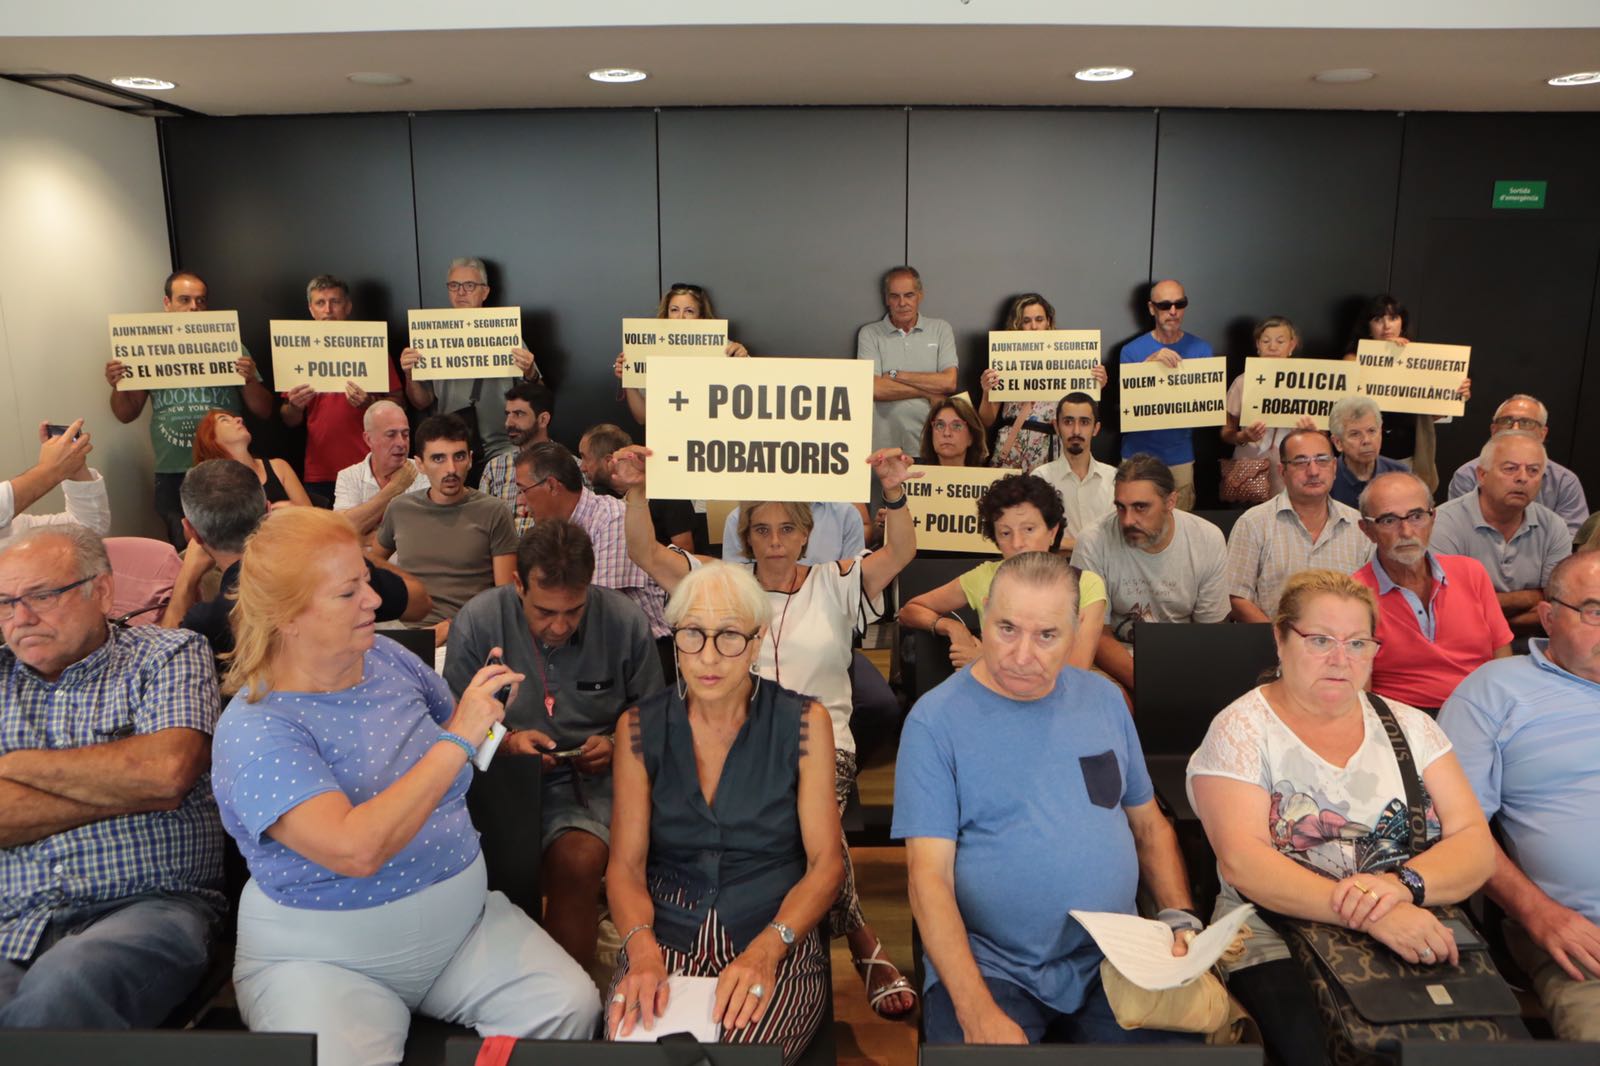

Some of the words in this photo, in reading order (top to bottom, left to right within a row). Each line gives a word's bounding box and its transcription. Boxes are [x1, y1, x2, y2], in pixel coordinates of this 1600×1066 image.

[112, 325, 173, 337] AJUNTAMENT
[185, 323, 236, 333] SEGURETAT
[411, 320, 464, 330] AJUNTAMENT
[474, 318, 518, 328] SEGURETAT
[273, 336, 310, 347] VOLEM
[324, 336, 385, 348] SEGURETAT
[427, 338, 438, 349] LA
[440, 338, 464, 348] TEVA
[467, 334, 519, 348] OBLIGACIÓ
[624, 333, 656, 344] VOLEM
[668, 334, 725, 346] SEGURETAT
[991, 342, 1044, 352] AJUNTAMENT
[1054, 341, 1098, 351] SEGURETAT
[131, 345, 145, 356] LA
[147, 344, 175, 356] TEVA
[178, 340, 238, 354] OBLIGACIÓ
[308, 361, 368, 377] POLICIA
[431, 357, 442, 368] EL
[446, 355, 489, 368] NOSTRE
[493, 354, 514, 366] DRE
[634, 362, 646, 374] VI
[1006, 361, 1017, 371] LA
[1019, 360, 1043, 370] TEVA
[1046, 358, 1098, 370] OBLIGACIÓ
[1359, 354, 1394, 368] VOLEM
[1406, 357, 1466, 372] SEGURETAT
[138, 365, 151, 377] EL
[156, 362, 205, 376] NOSTRE
[1008, 379, 1019, 390] EL
[1024, 378, 1067, 390] NOSTRE
[1122, 376, 1156, 389] VOLEM
[1168, 371, 1224, 386] SEGURETAT
[1275, 372, 1346, 391] POLICIA
[708, 384, 852, 421] POLICIA
[1133, 399, 1224, 417] VIDEOVIGILÀNCIA
[1261, 398, 1335, 416] ROBATORI
[159, 424, 192, 448] INTERNA
[686, 440, 849, 475] ROBATORIS
[926, 513, 983, 534] POLICI
[1380, 715, 1410, 762] TOUS
[1410, 805, 1425, 850] TOU
